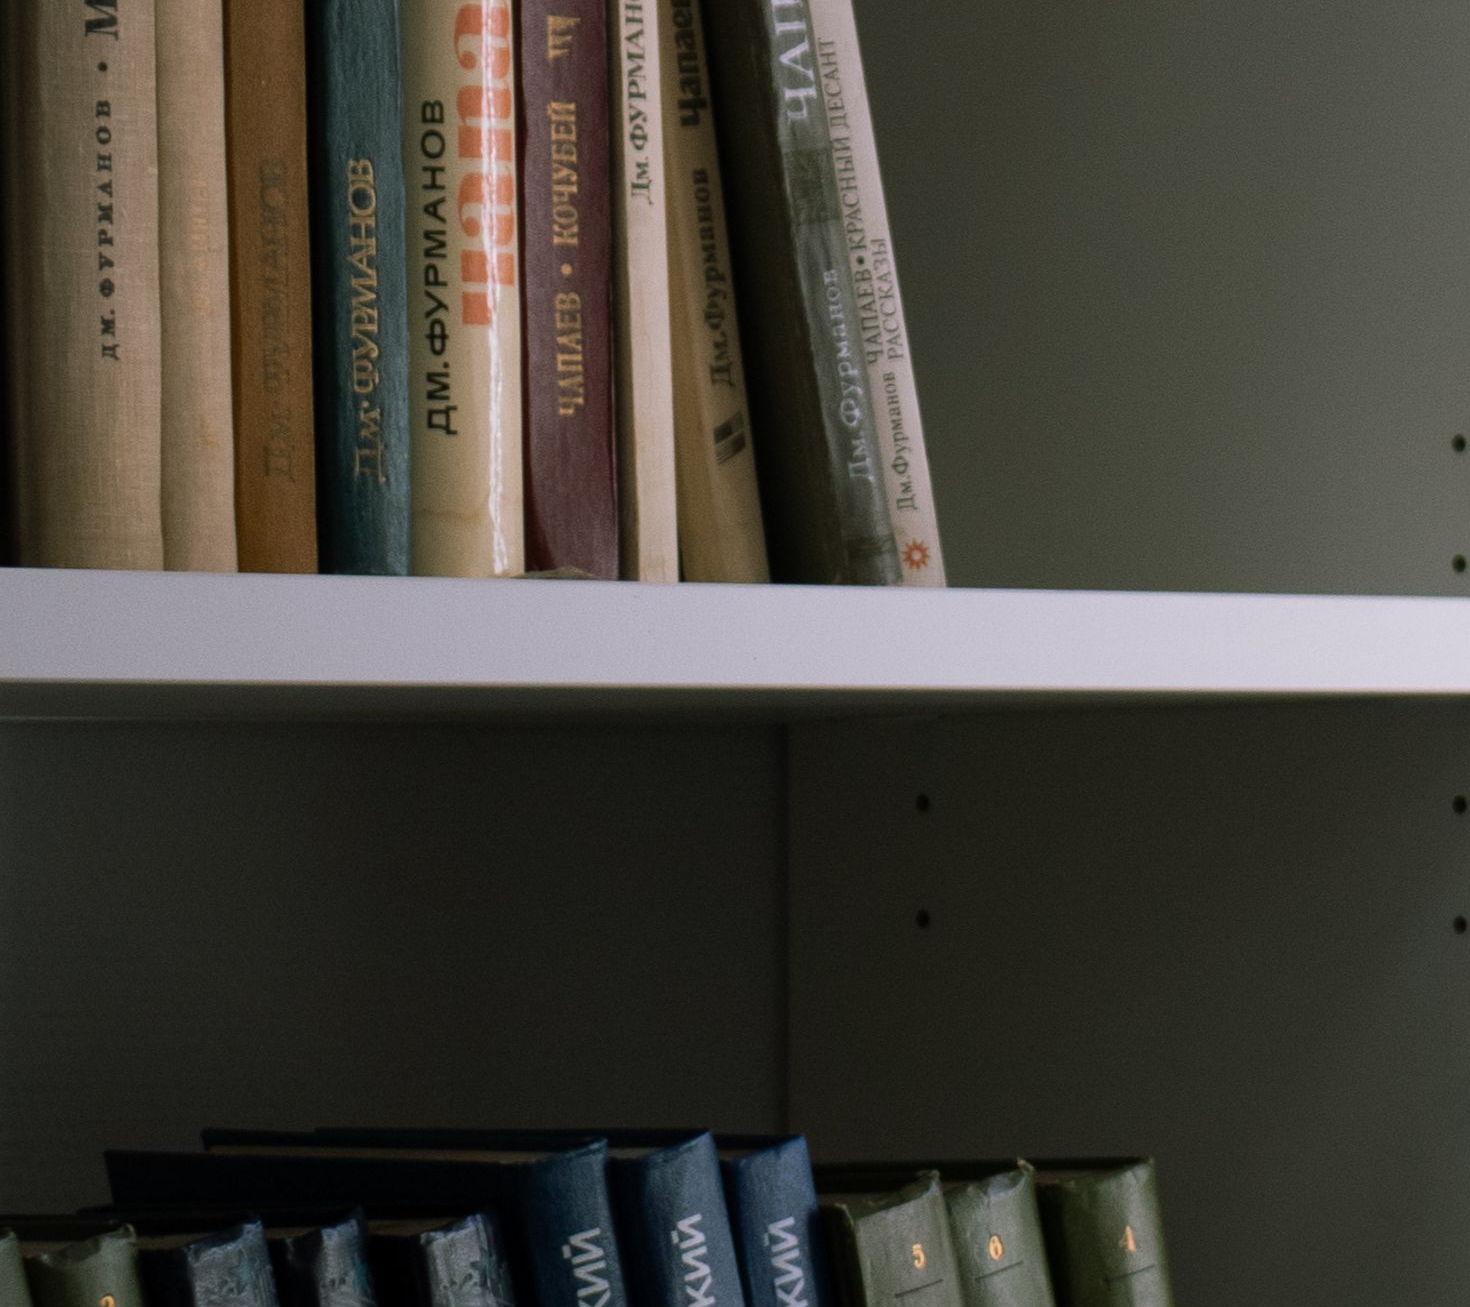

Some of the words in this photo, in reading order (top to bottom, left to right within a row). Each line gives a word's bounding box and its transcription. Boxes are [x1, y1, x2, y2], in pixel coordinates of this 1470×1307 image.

[815, 37, 847, 139] ДЕСАНТ
[95, 99, 117, 299] ФУРМАНОВ
[550, 101, 581, 247] КОЧУБЕЙ
[830, 141, 867, 255] КРАСНЫЙ
[98, 307, 120, 362] ДМ.
[852, 267, 880, 366] ЧАПАЕВ
[871, 237, 903, 361] РАССКАЗЫ
[553, 292, 586, 417] ЧАПАЕВ
[910, 1243, 928, 1270] 5
[988, 1234, 1004, 1262] 6
